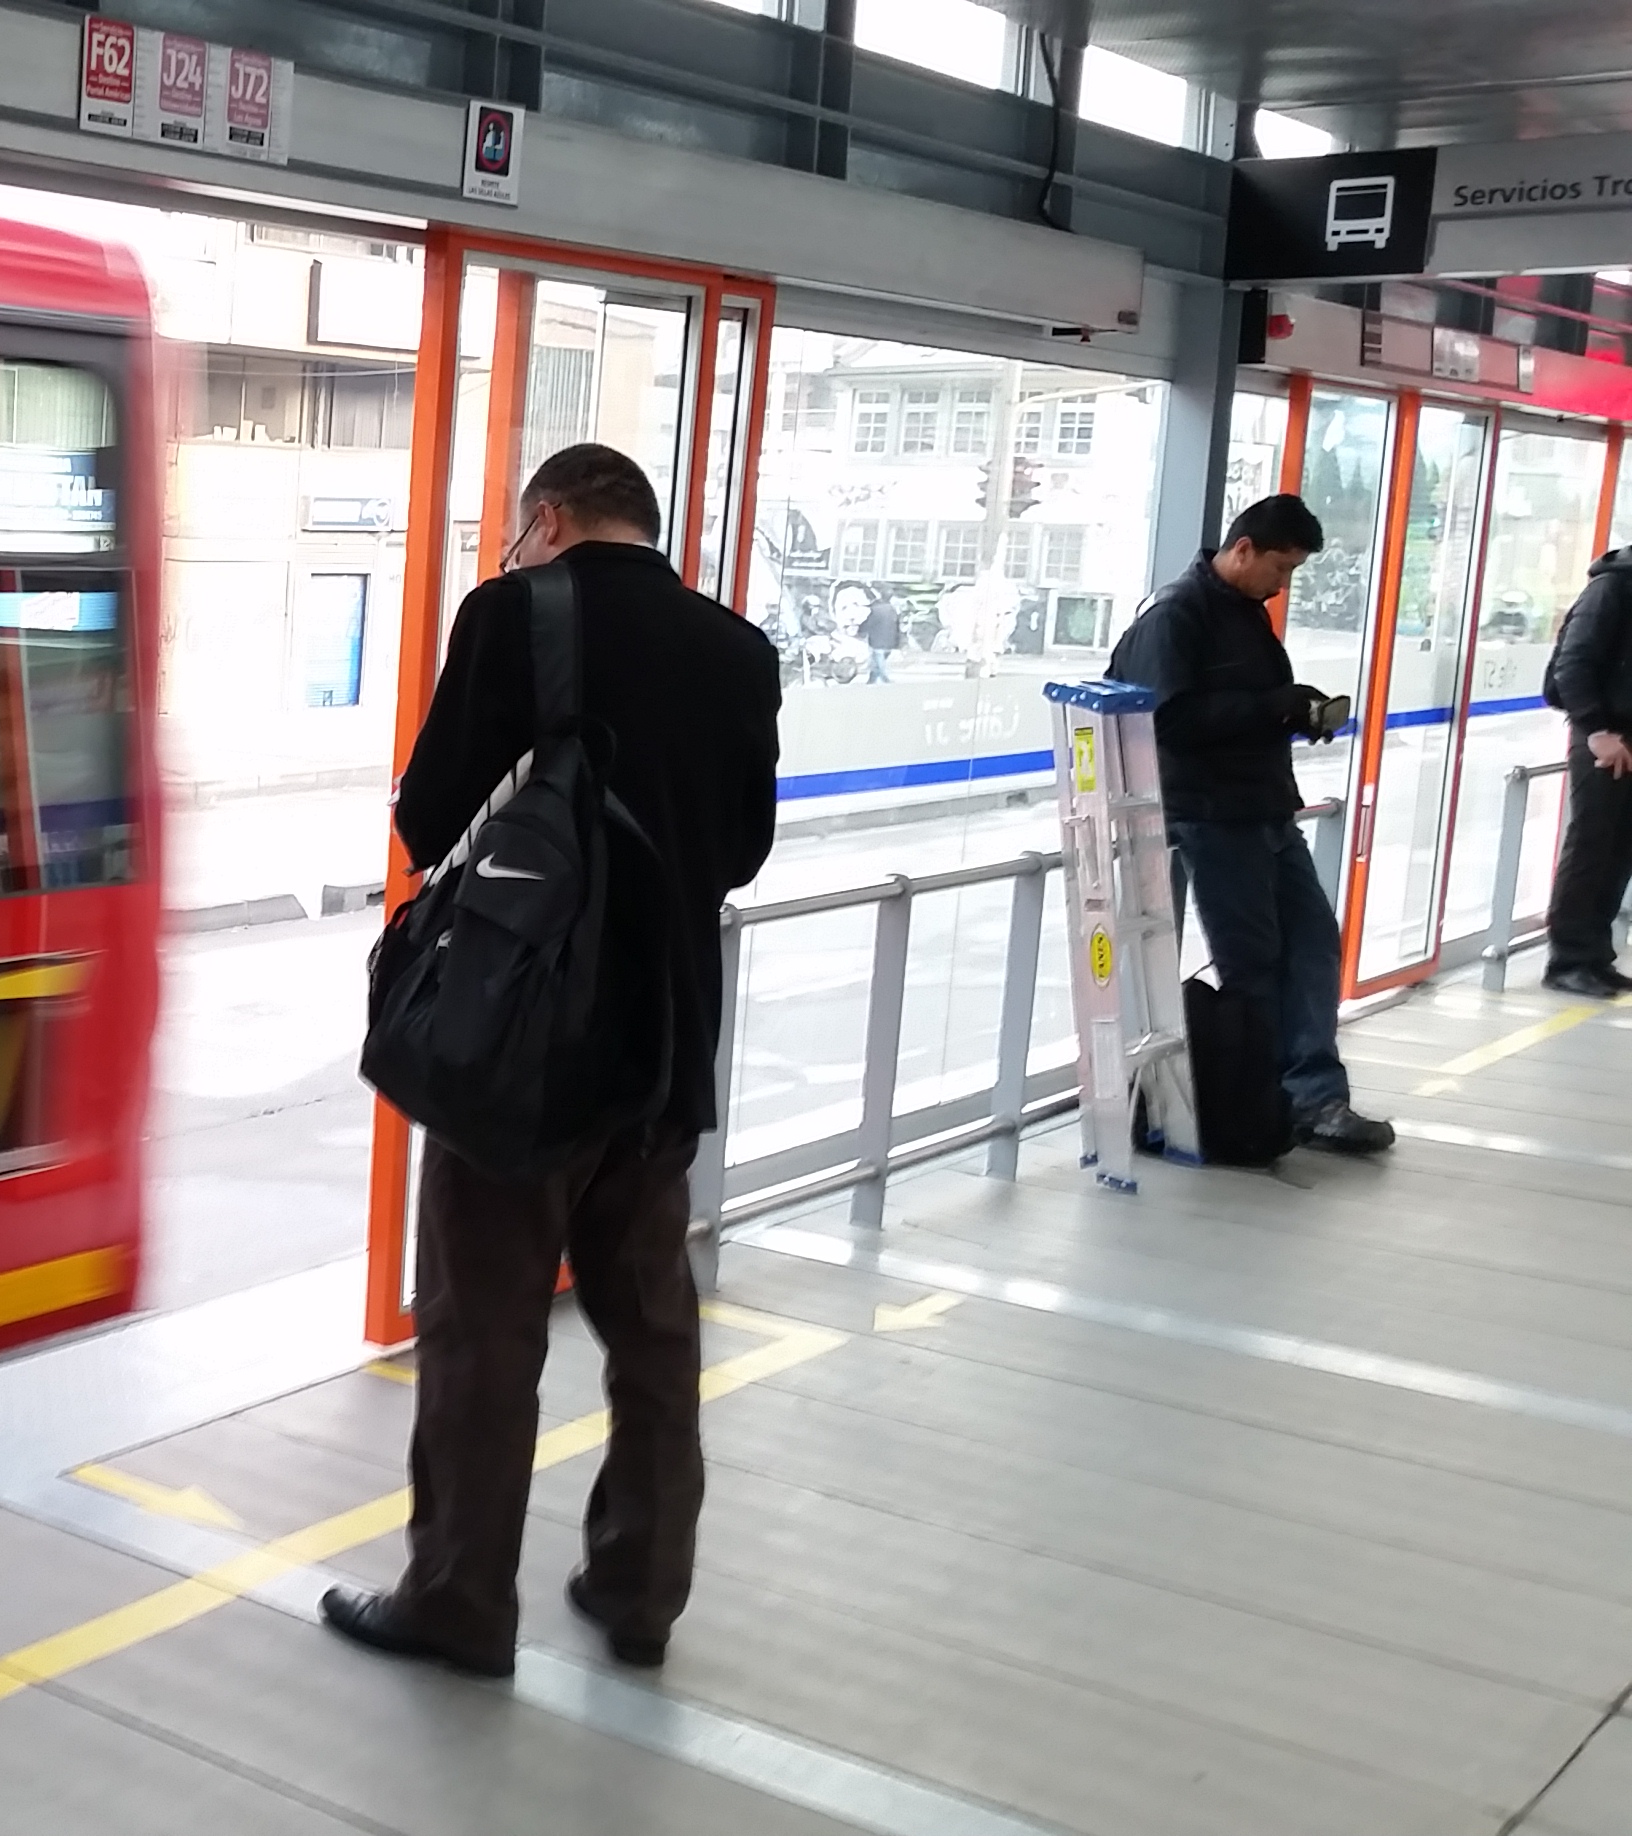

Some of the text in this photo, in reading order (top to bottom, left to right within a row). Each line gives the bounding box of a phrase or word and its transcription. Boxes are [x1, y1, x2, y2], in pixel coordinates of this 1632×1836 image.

[90, 32, 131, 77] F62
[163, 48, 203, 91] J24
[231, 63, 268, 104] J72
[1454, 179, 1582, 207] Servicios
